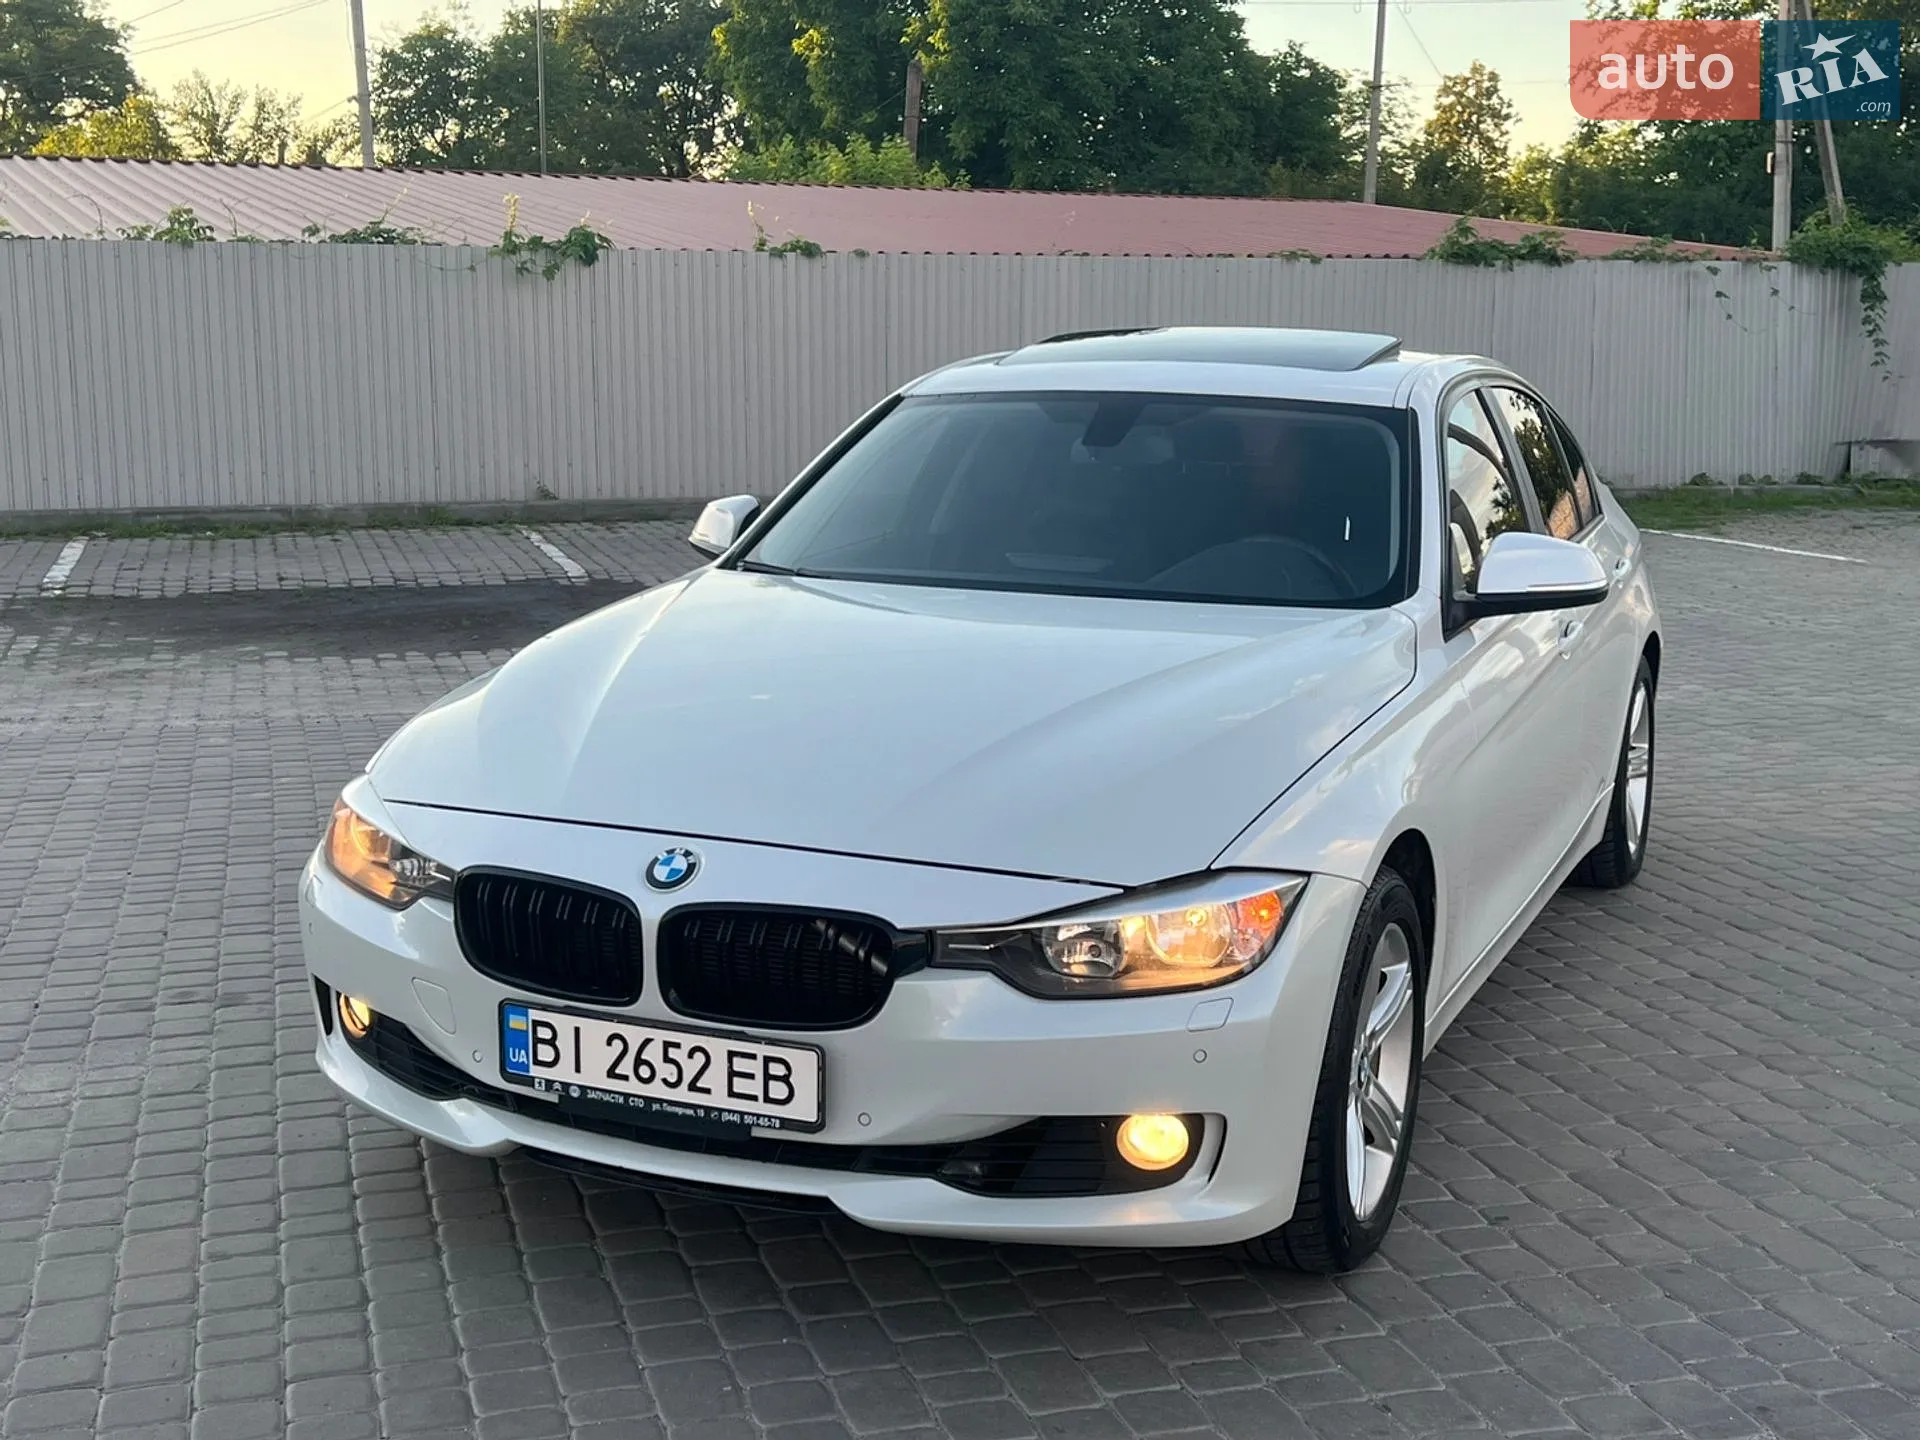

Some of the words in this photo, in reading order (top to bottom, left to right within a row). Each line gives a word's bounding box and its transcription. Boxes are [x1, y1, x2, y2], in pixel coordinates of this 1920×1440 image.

[509, 1047, 528, 1065] UA
[531, 1019, 581, 1073] BI
[606, 1032, 712, 1095] 2652
[727, 1049, 795, 1106] EB
